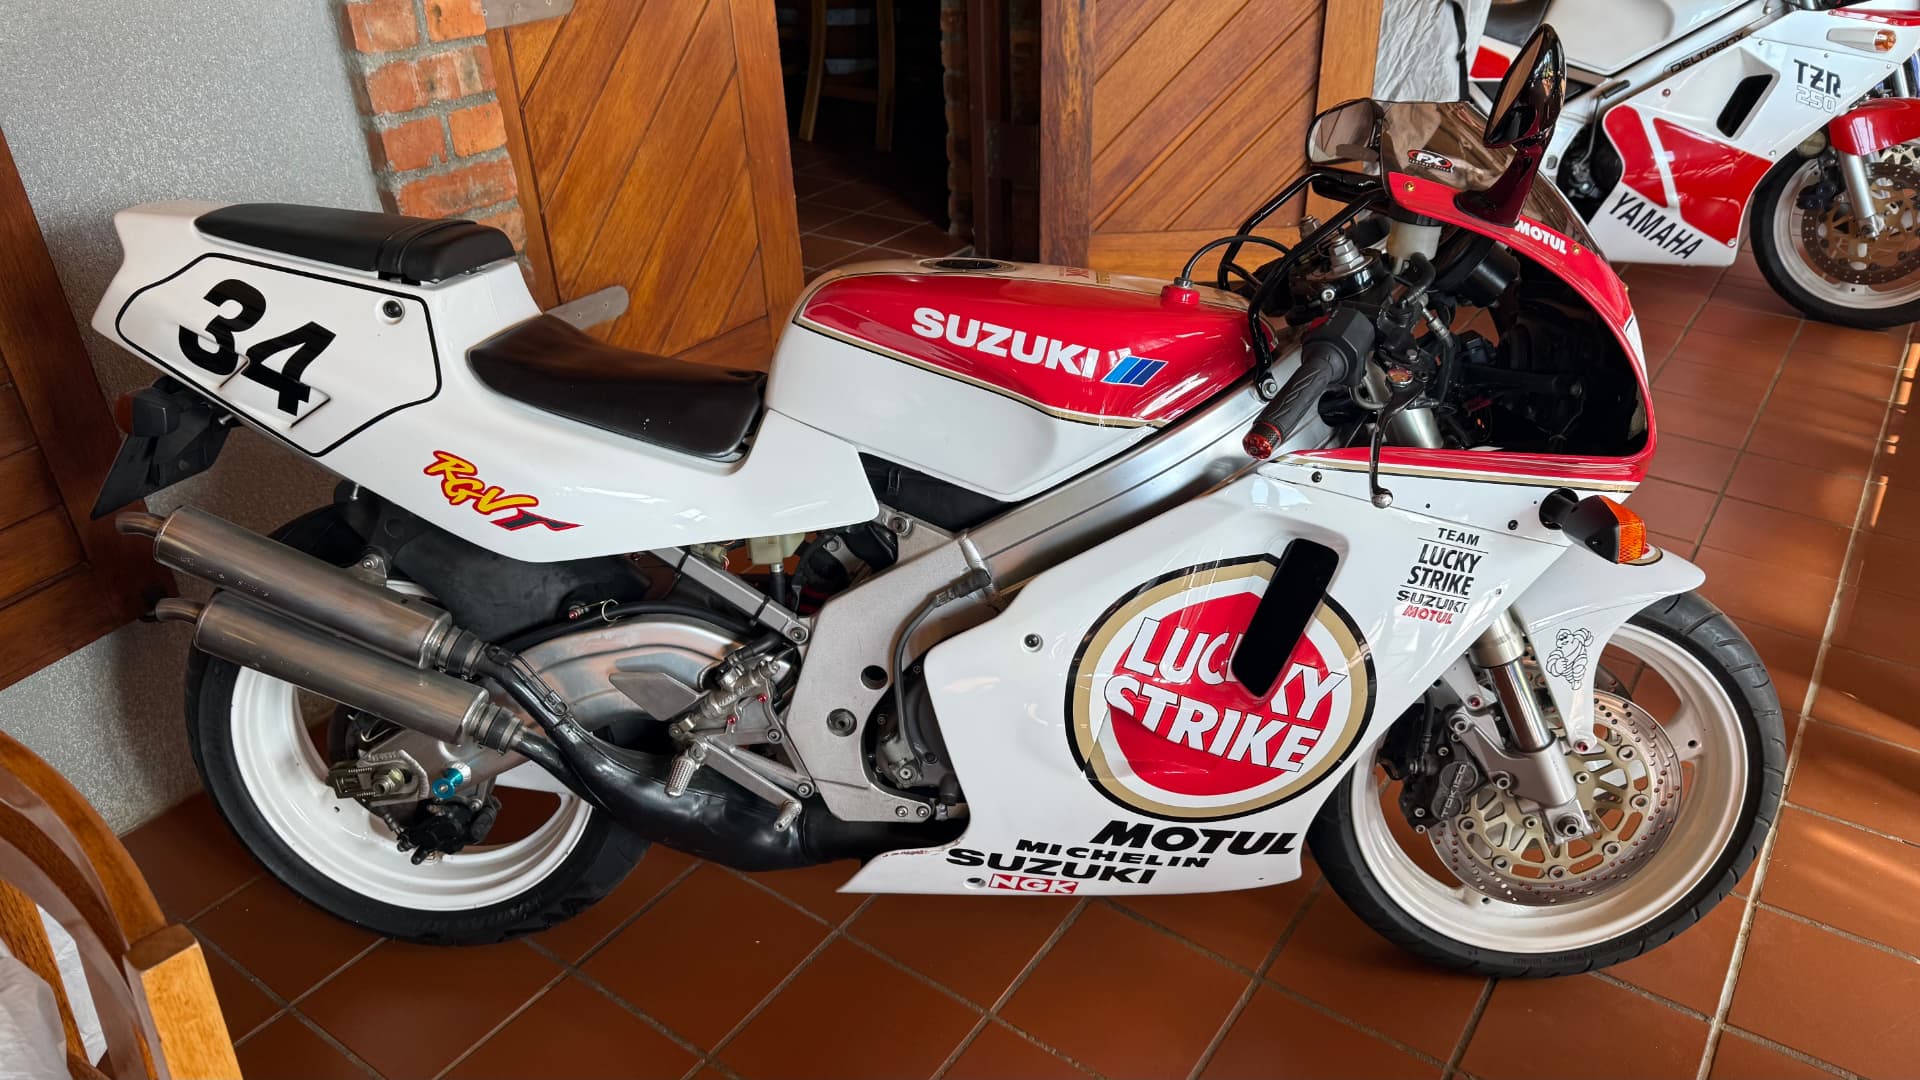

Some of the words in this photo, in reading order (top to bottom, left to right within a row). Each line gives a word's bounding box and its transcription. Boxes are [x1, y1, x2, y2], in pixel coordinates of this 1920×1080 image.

[1670, 32, 1745, 74] DELTABOX
[1793, 59, 1842, 98] TZR
[1795, 85, 1838, 114] 250
[1514, 220, 1567, 255] MOTUL
[1609, 191, 1704, 260] YAMAHA
[178, 278, 337, 416] 34
[911, 306, 1100, 379] SUZUKI
[1438, 527, 1480, 546] TEAM
[1418, 543, 1482, 574] LUCKY
[1407, 565, 1475, 596] STRIKE
[1396, 590, 1468, 614] SUZUKI
[1402, 604, 1454, 625] MOTUL
[1103, 673, 1323, 773] STRIKE
[1441, 762, 1468, 819] TOKICO
[1015, 839, 1210, 868] MICHELIN
[1088, 820, 1299, 856] MOTUL
[945, 848, 1157, 884] SUZUKI
[991, 874, 1079, 895] NGK
